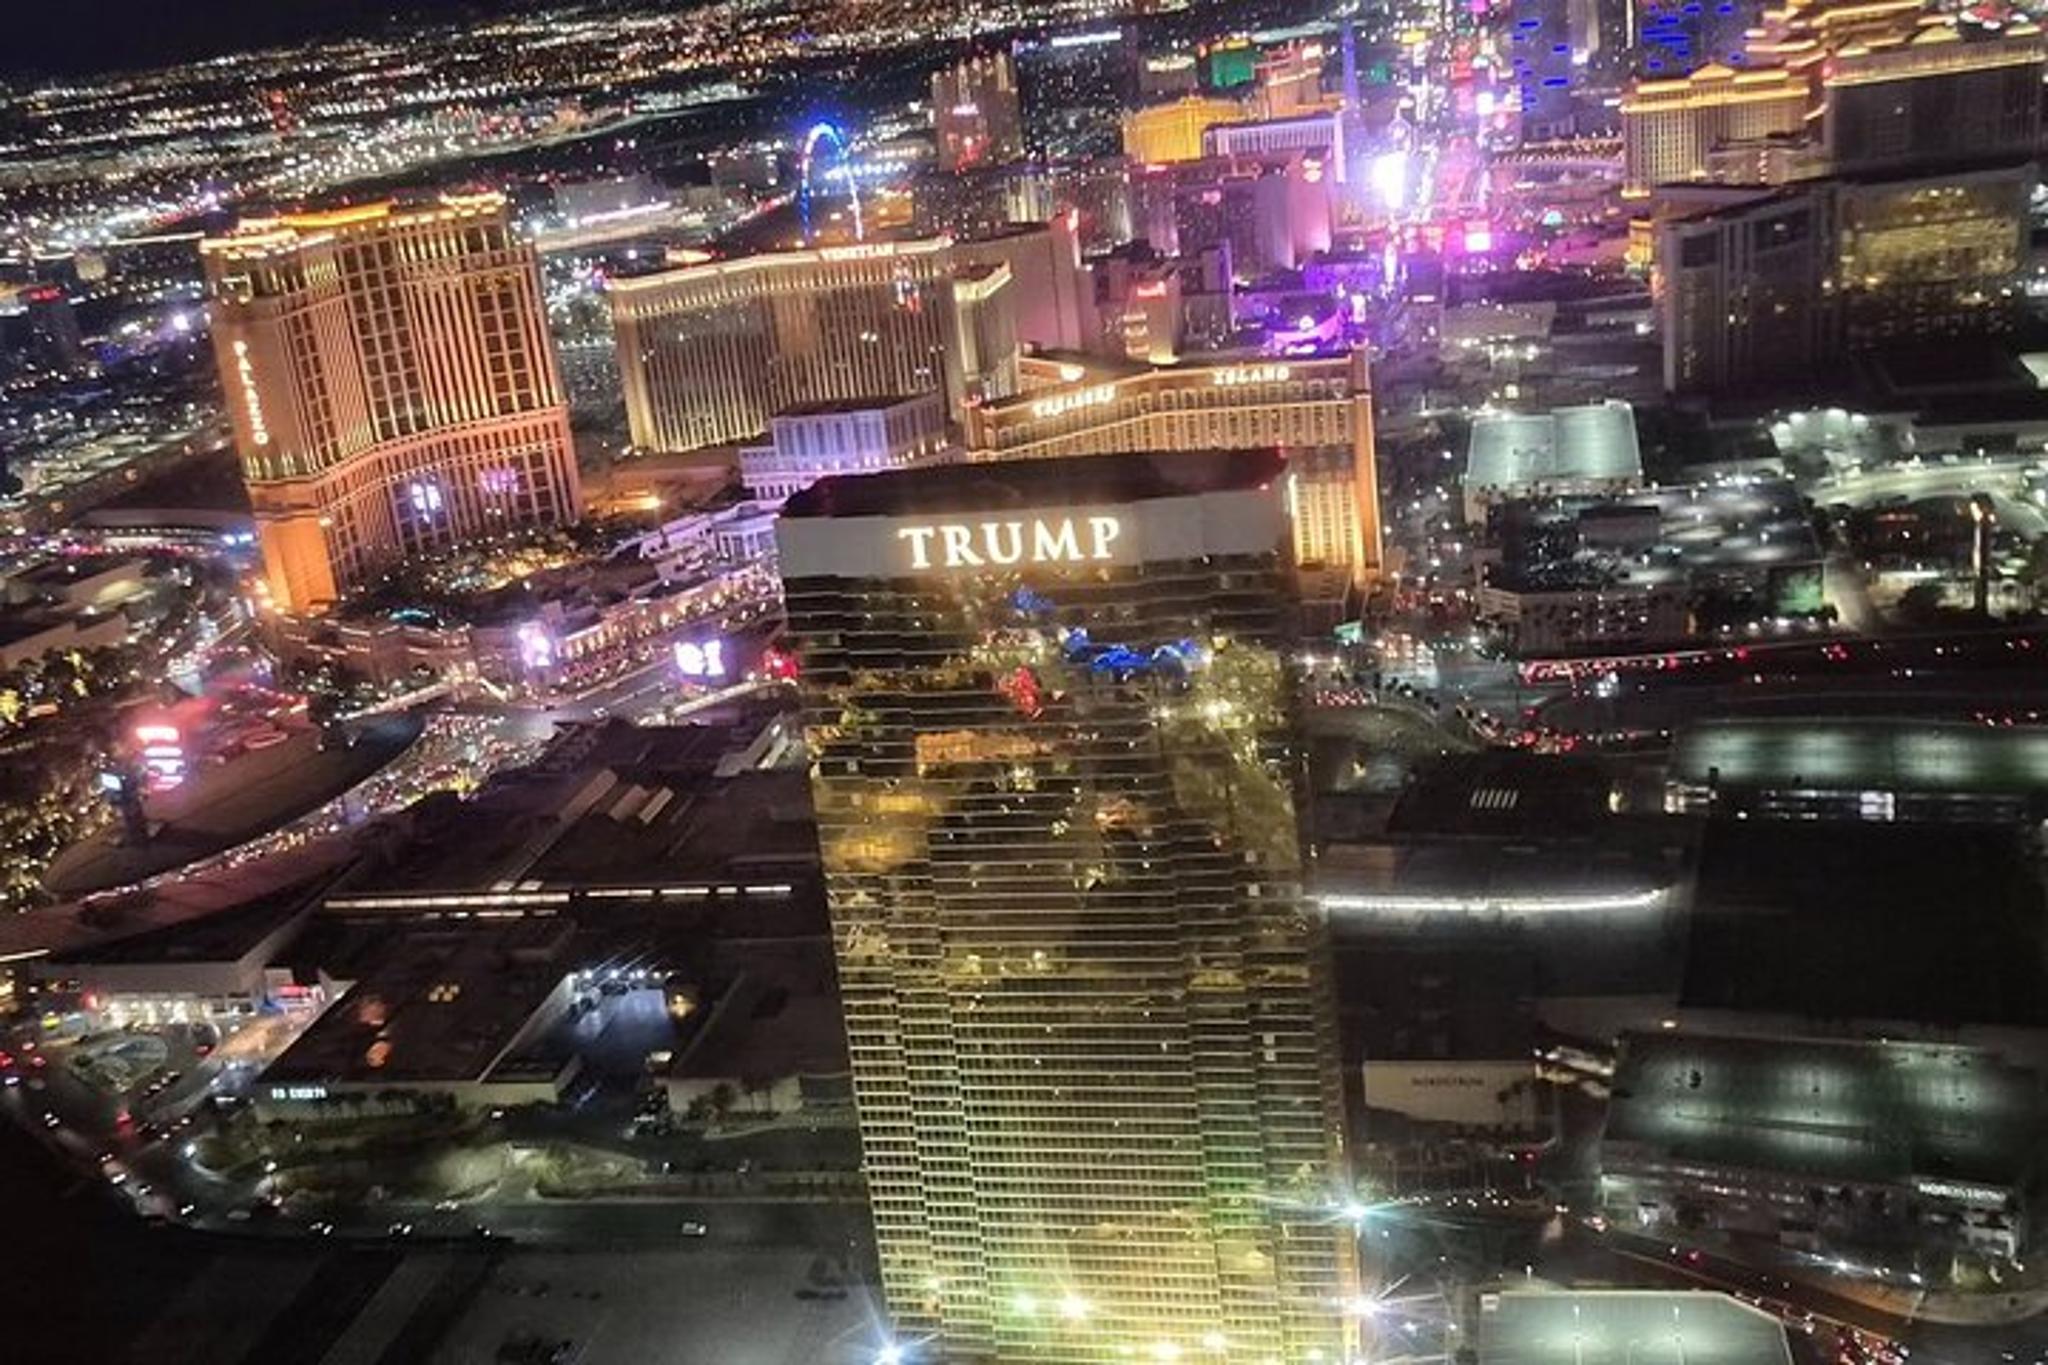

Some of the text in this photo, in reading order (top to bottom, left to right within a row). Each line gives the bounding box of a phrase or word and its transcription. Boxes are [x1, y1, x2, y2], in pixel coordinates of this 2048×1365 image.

[233, 340, 269, 445] PALAZZO
[1213, 366, 1290, 385] ISLAND
[898, 517, 1120, 569] TRUMP
